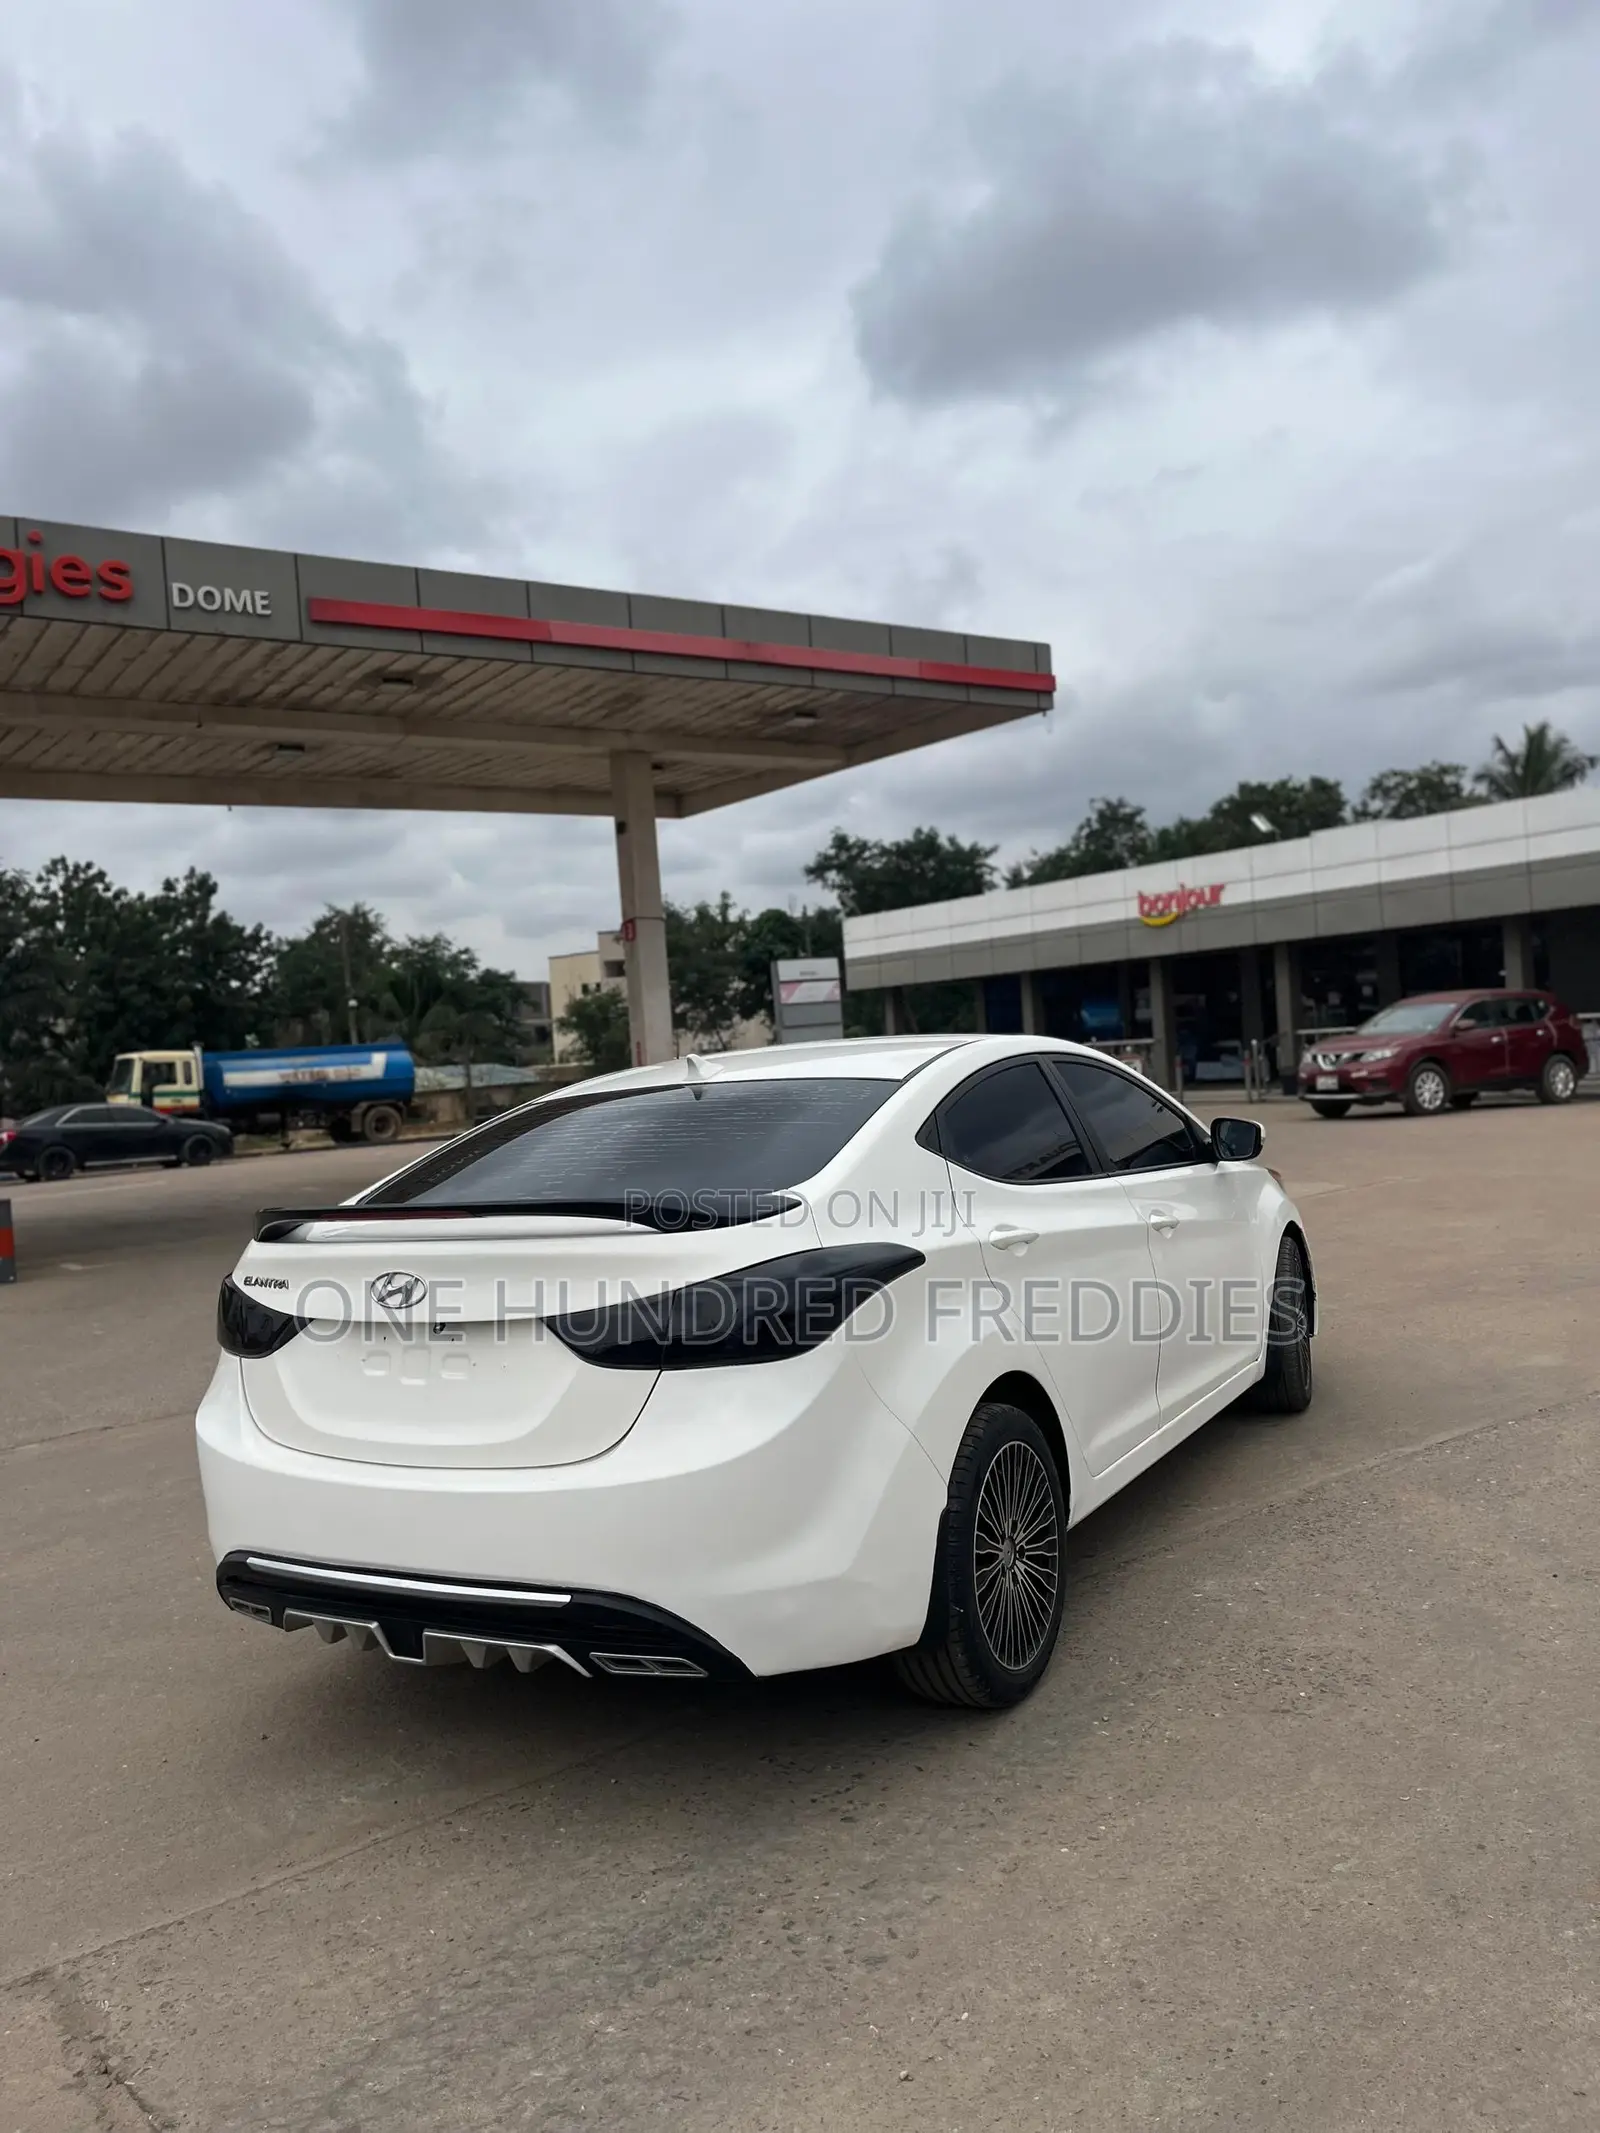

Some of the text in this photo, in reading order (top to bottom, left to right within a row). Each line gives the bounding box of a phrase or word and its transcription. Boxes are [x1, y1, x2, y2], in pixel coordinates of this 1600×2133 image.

[171, 582, 272, 616] DOME
[1137, 883, 1225, 917] bonjour
[243, 1276, 289, 1290] ELANTRA
